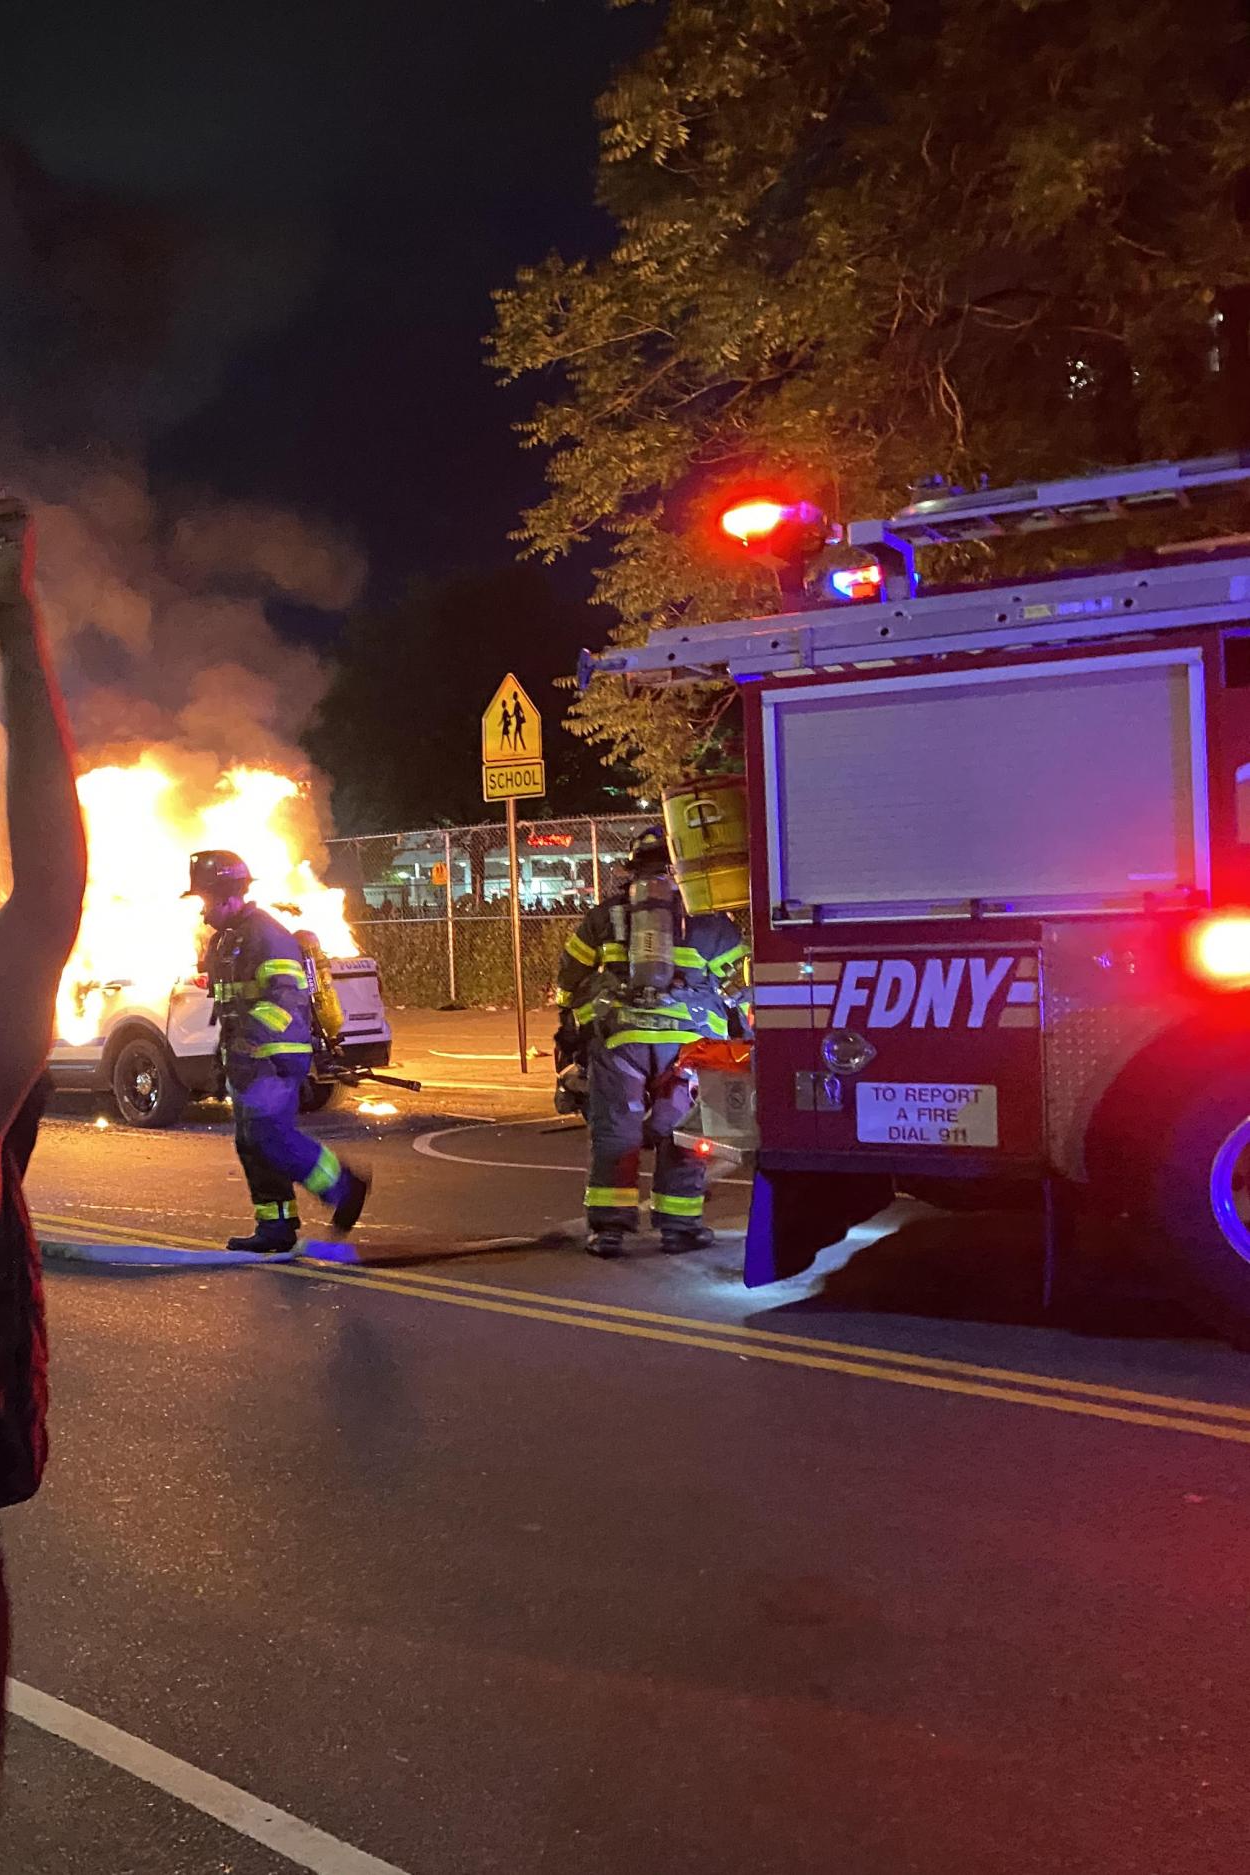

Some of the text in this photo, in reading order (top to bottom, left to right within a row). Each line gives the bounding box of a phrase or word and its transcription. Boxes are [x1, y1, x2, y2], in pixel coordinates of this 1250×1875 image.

[489, 770, 540, 790] SCHOOL
[832, 957, 1015, 1028] FDNY
[872, 1086, 982, 1103] TO REPORT
[896, 1107, 959, 1122] A FIRE
[888, 1126, 968, 1143] DIAL 911
